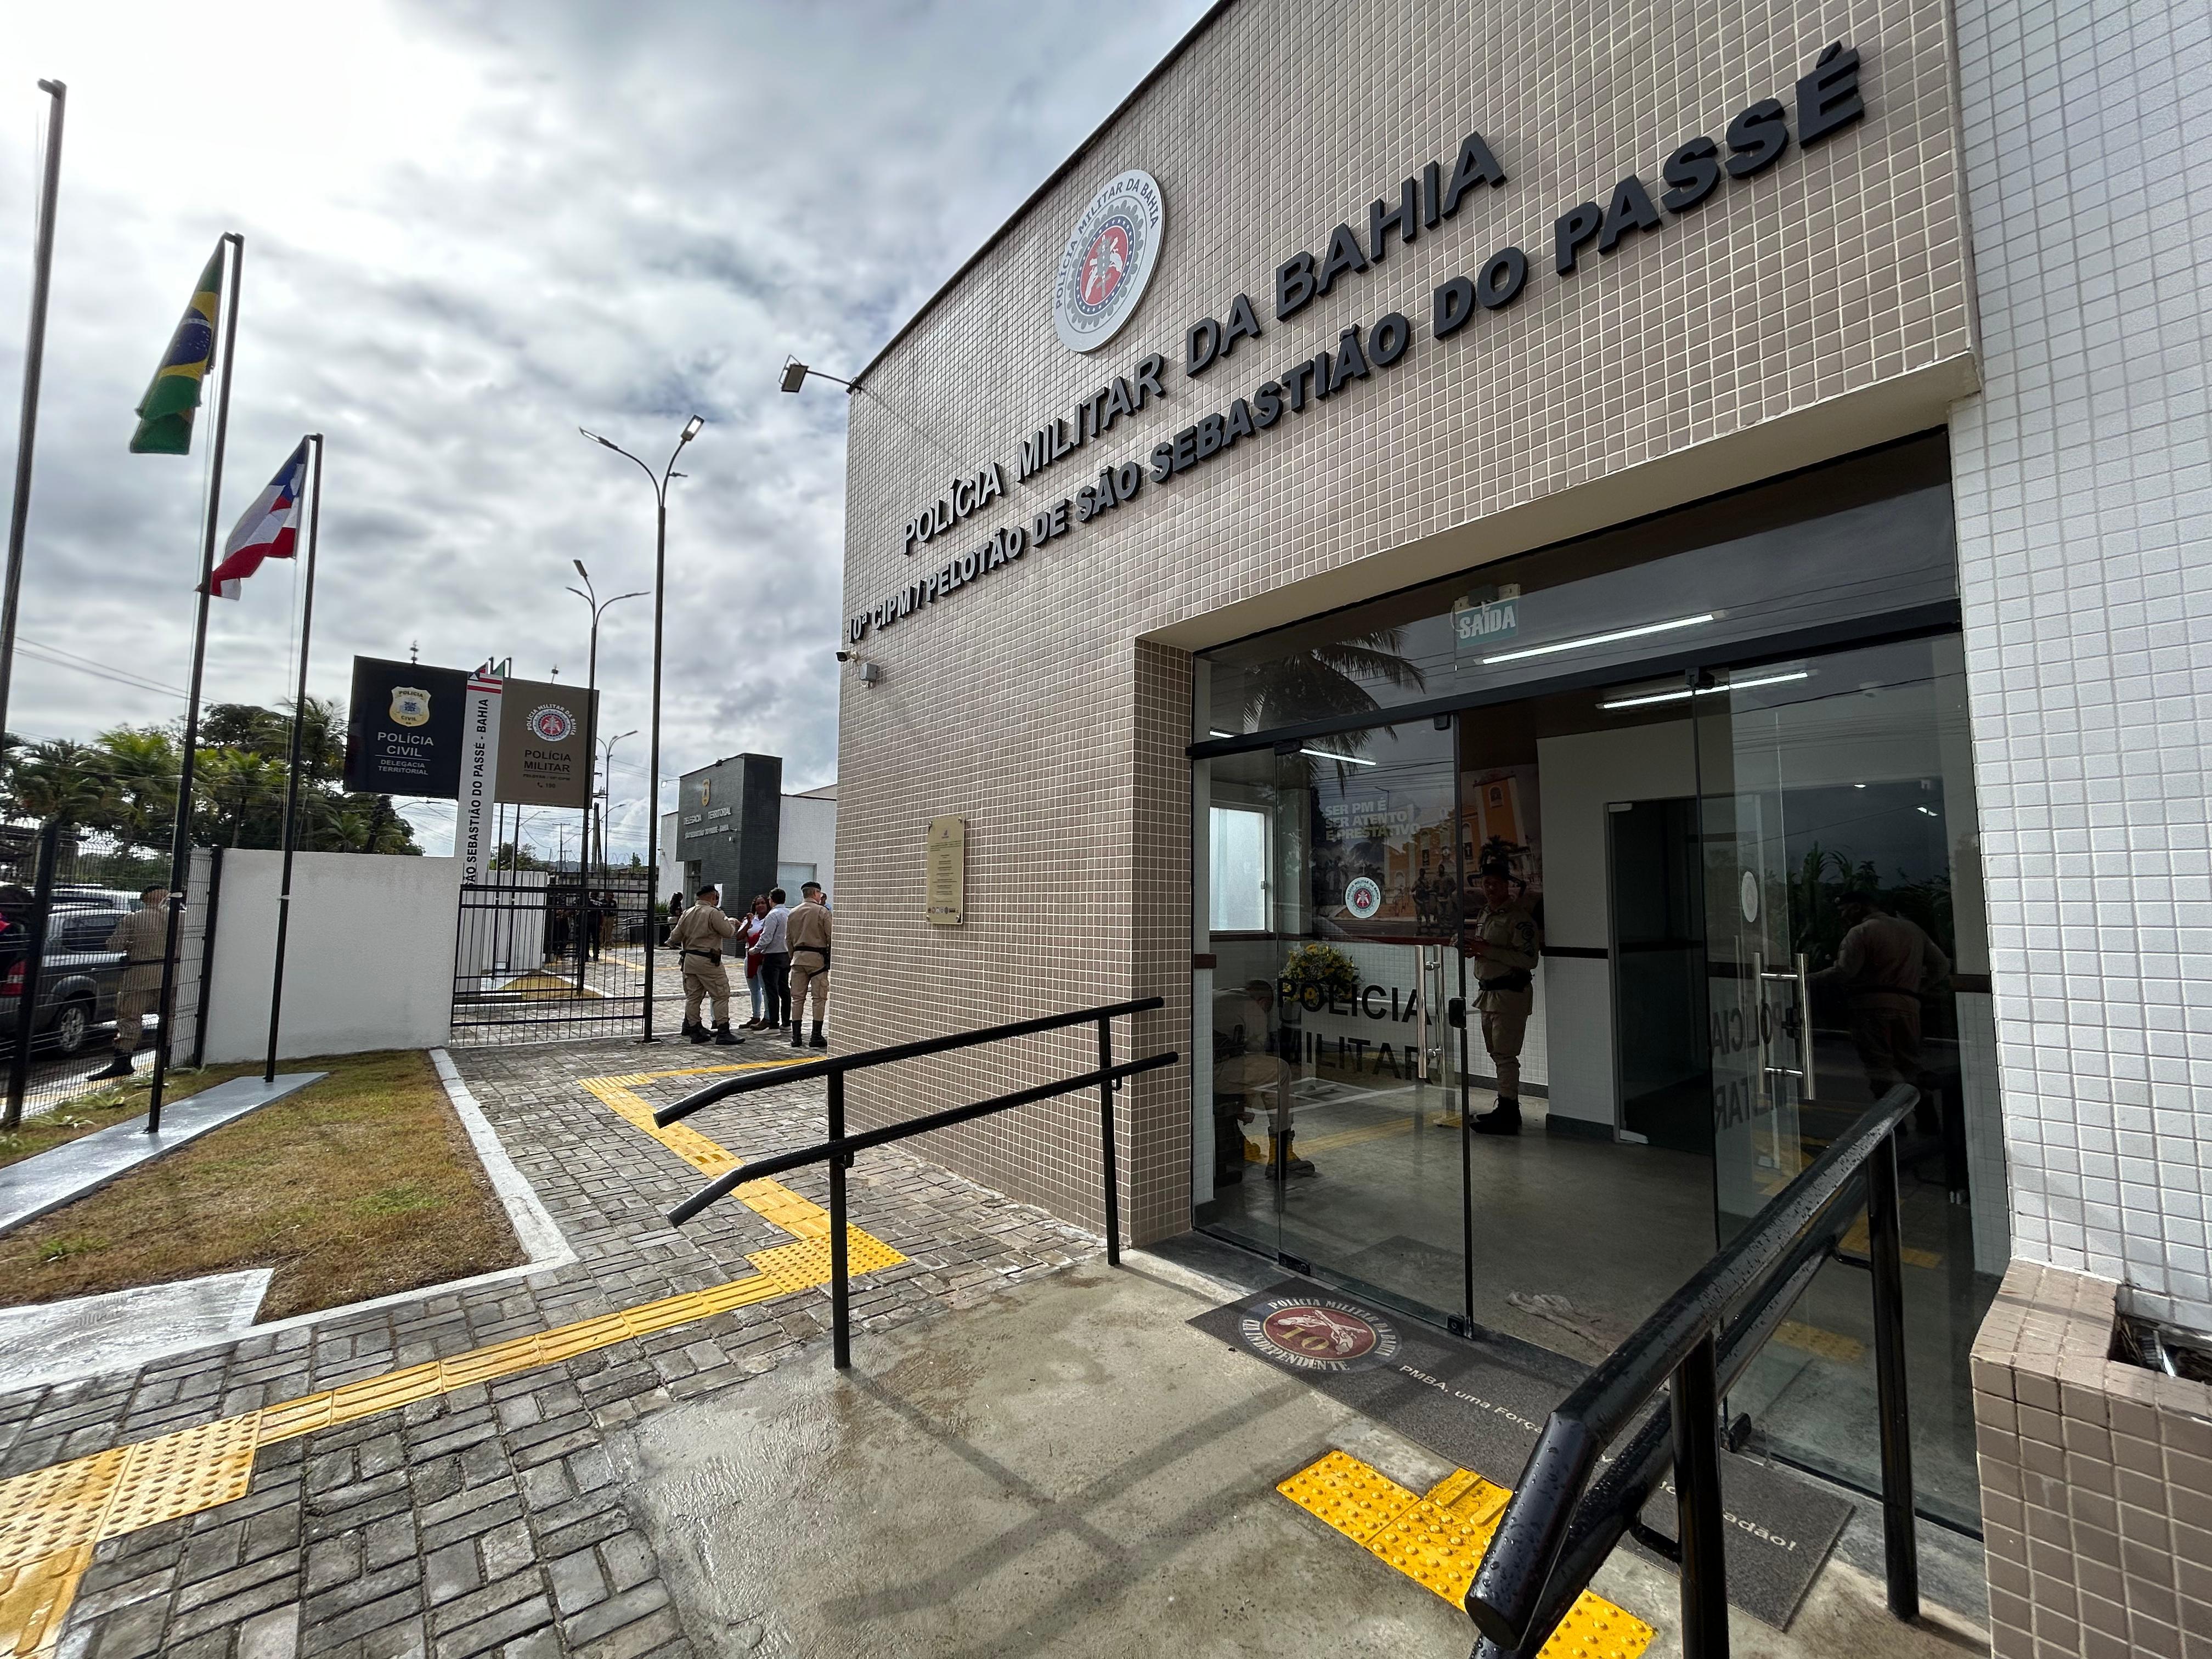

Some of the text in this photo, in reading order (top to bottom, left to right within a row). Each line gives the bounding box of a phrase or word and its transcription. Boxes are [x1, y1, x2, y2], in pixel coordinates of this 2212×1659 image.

[1056, 178, 1159, 310] POLÍCIA MILITAR DA BAHIA
[871, 585, 915, 631] CIPM
[915, 579, 926, 610] /
[926, 527, 1026, 603] PELOTÃO
[1032, 498, 1073, 548] DE
[1075, 461, 1142, 523] SÃO
[1150, 312, 1412, 483] SEBASTIÃO
[1434, 247, 1528, 339] DO
[1554, 40, 1865, 275] PASSÉ
[903, 131, 1507, 555] POLÍCIA MILITAR DA BAHIA
[1459, 605, 1516, 639] SAÍDA
[477, 698, 488, 733] BAHIA
[526, 709, 538, 731] POLÍCIA
[565, 710, 573, 719] DA
[377, 731, 434, 746] POLÍCIA
[386, 745, 422, 757] CIVIL
[473, 742, 486, 777] PASSÉ
[524, 749, 571, 762] POLÍCIA
[377, 765, 428, 775] TERRITORIAL
[381, 759, 425, 768] DELEGACIA
[524, 761, 570, 772] MILITAR
[472, 779, 482, 797] DO
[1325, 797, 1386, 816] SER PM É
[1325, 811, 1408, 828] SER ATENTO
[466, 799, 482, 864] SEBASTIÃO
[1336, 823, 1420, 840] PRESTATIVO
[1325, 1300, 1379, 1323] MILITAR
[1277, 1326, 1330, 1351] 10
[1376, 1322, 1392, 1333] DA
[1244, 1332, 1350, 1371] INDEPENDENTE
[1374, 1334, 1397, 1356] BAHIA
[1399, 1365, 1449, 1392] PMBA,
[1454, 1391, 1491, 1409] uma
[1493, 1406, 1543, 1434] Força
